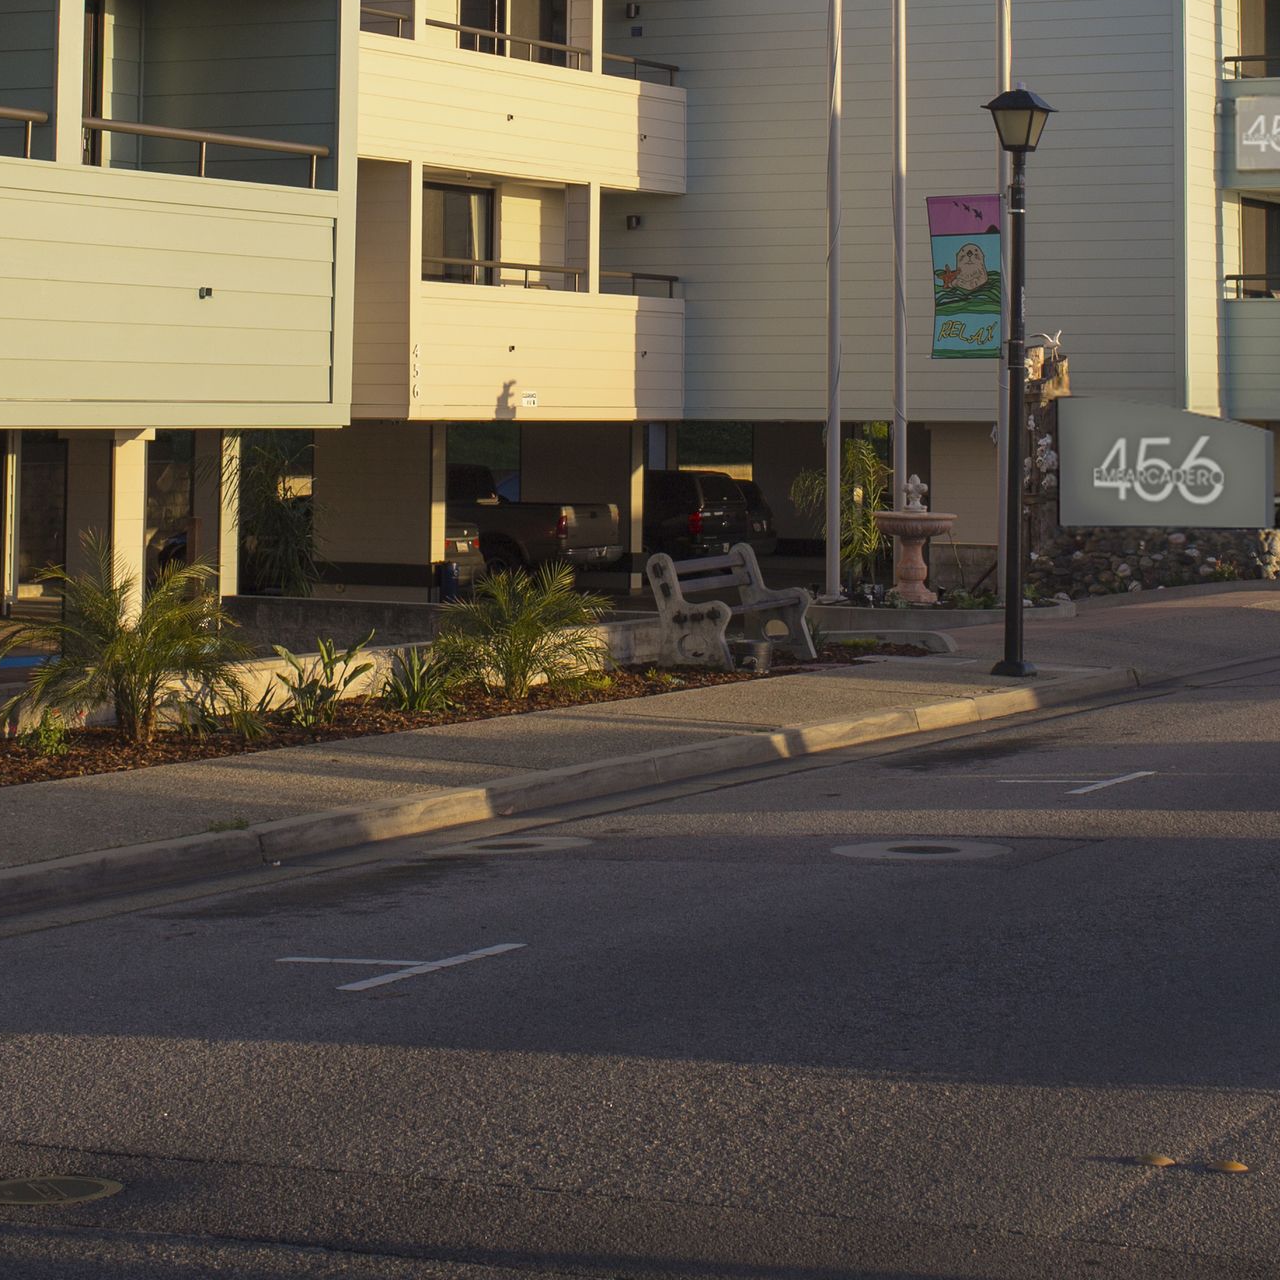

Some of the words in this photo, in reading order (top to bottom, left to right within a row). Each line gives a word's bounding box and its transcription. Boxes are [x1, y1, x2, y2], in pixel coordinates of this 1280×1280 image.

[938, 320, 998, 345] RELAX
[1093, 435, 1224, 505] 456
[1093, 467, 1224, 487] EMBARCADERO
